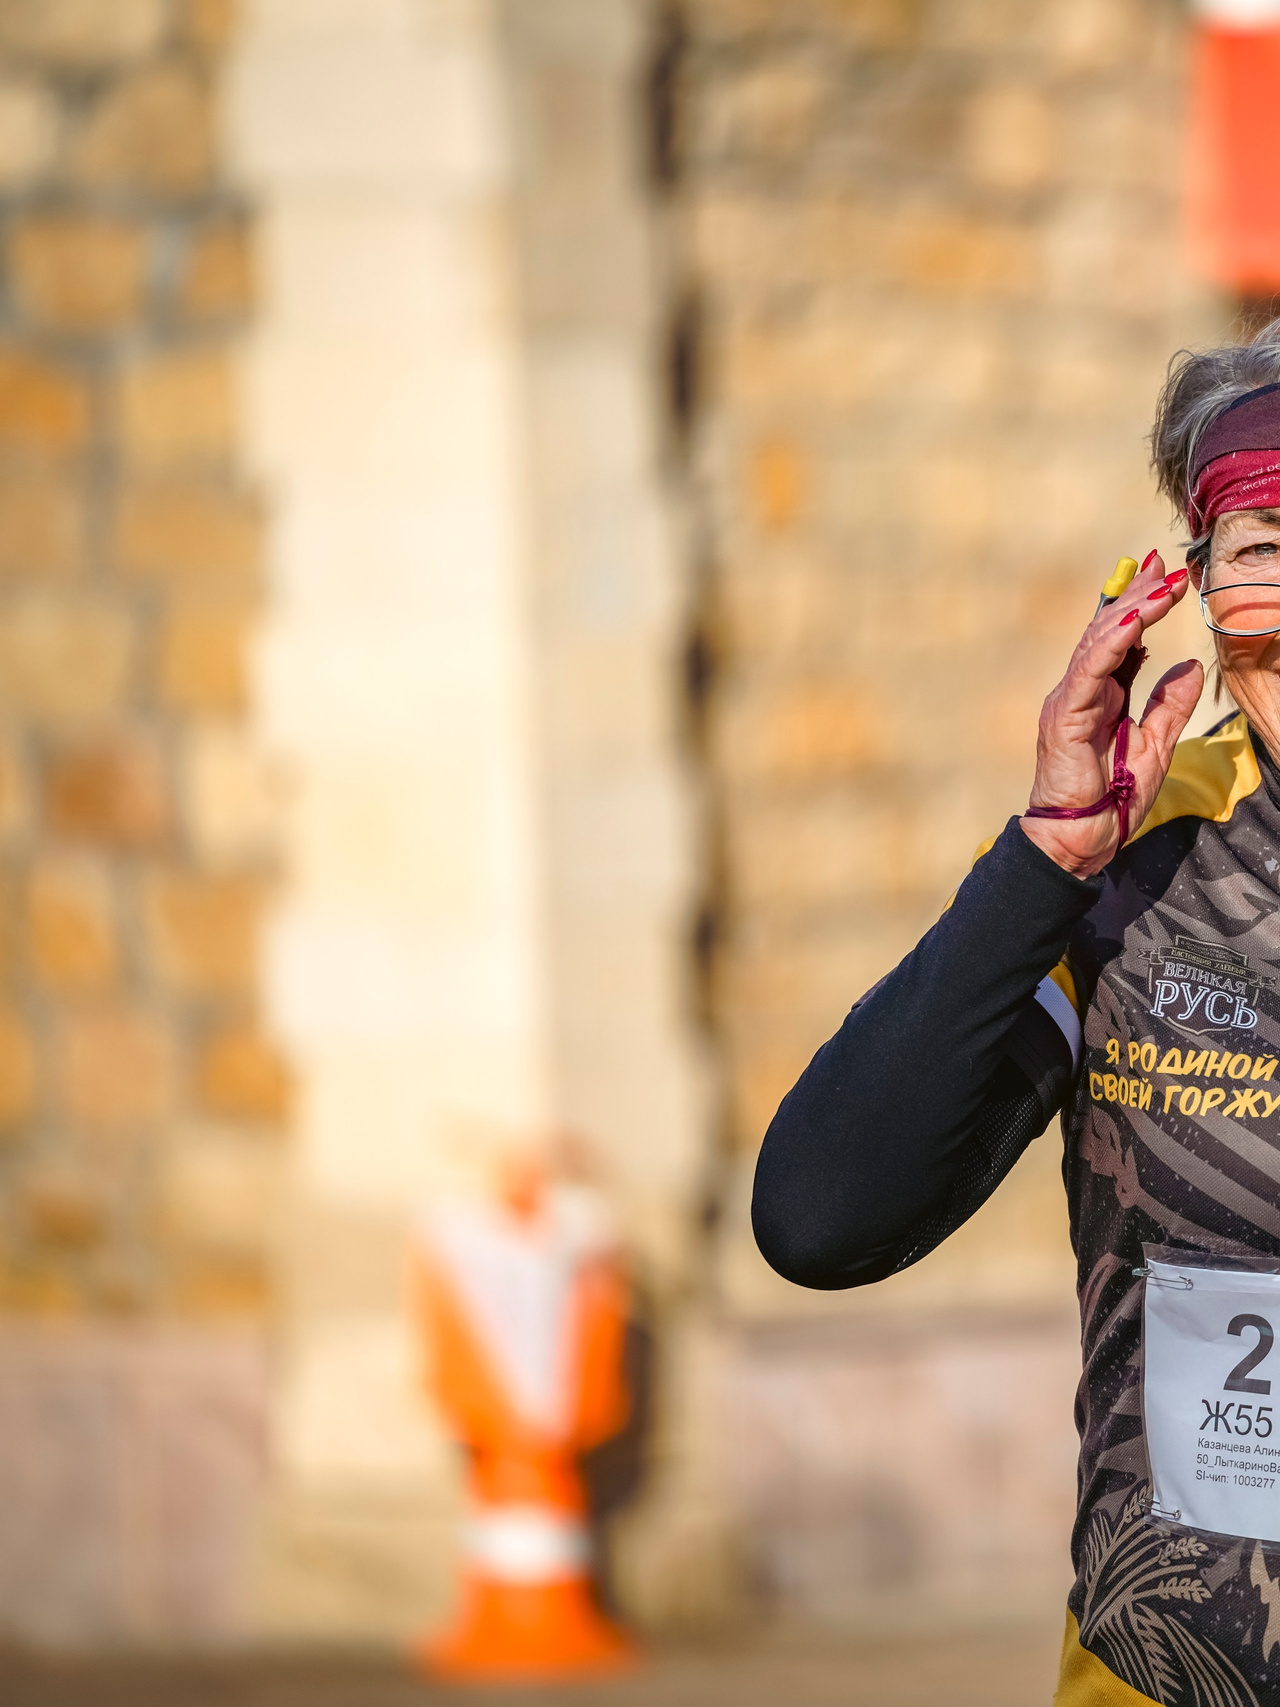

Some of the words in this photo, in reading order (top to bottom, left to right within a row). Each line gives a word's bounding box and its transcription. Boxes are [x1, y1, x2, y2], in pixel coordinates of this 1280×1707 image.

[1163, 961, 1248, 996] ВЕЛИКАЯ
[1150, 979, 1258, 1029] РУСЬ
[1105, 1038, 1120, 1065] Я
[1127, 1041, 1280, 1082] РОДИНОЙ
[1089, 1072, 1153, 1112] СВОЕЙ
[1199, 1398, 1274, 1438] Ж55
[1197, 1437, 1251, 1453] Казанцева
[1195, 1469, 1229, 1484] SI-чип:
[1233, 1474, 1276, 1489] 1003277
